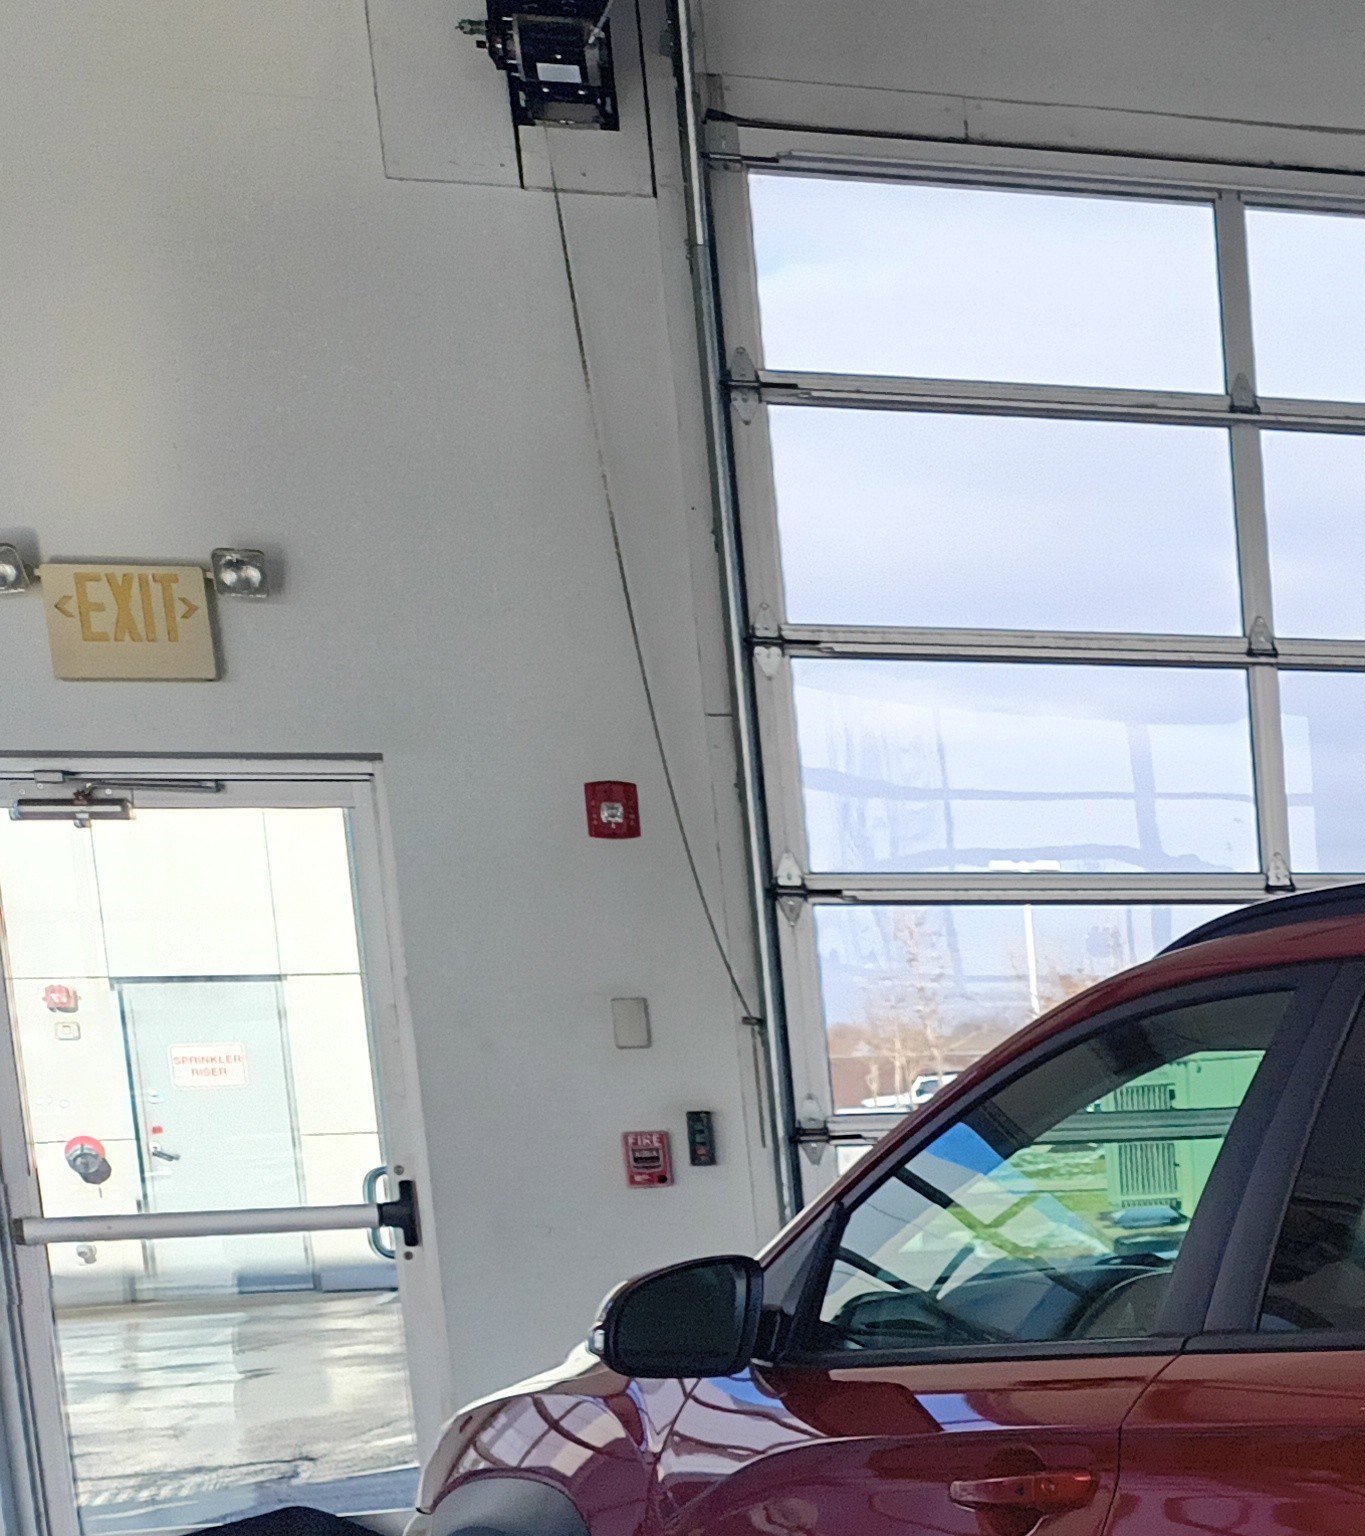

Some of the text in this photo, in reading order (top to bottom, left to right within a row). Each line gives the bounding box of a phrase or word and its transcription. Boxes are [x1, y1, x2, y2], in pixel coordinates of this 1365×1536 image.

[73, 571, 180, 643] EXIT
[173, 1055, 244, 1065] SPRINKLER
[191, 1067, 228, 1077] RISER
[627, 1133, 663, 1147] FIRE
